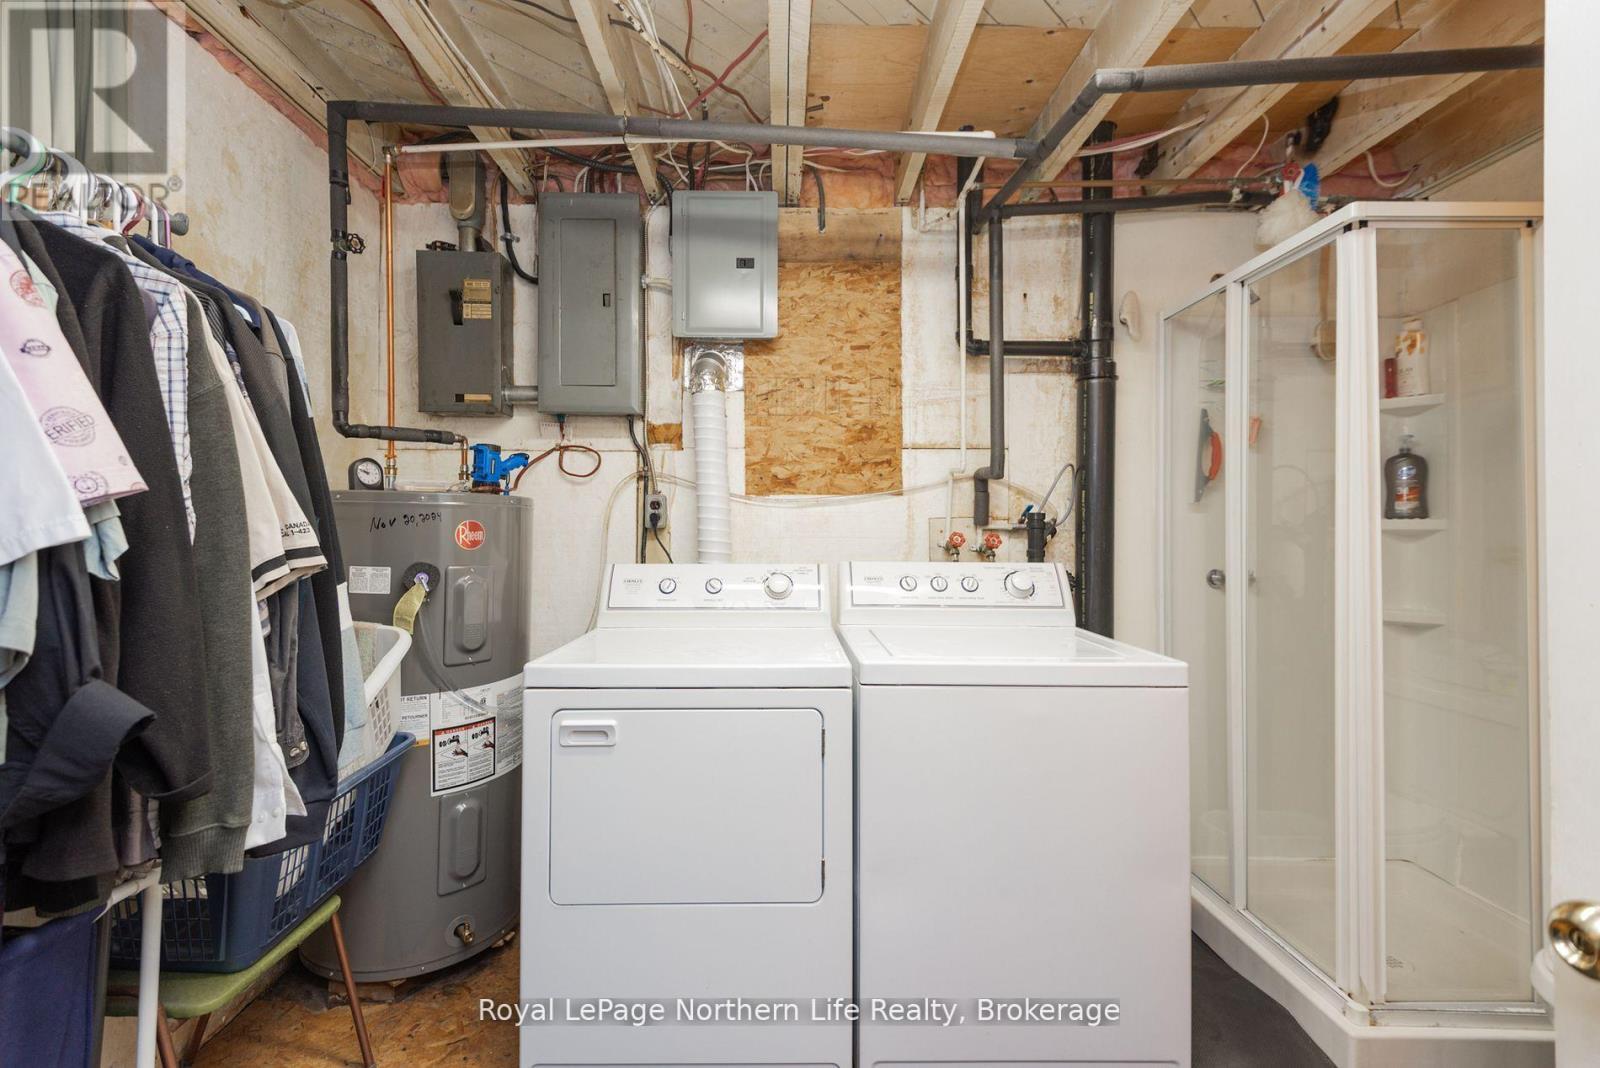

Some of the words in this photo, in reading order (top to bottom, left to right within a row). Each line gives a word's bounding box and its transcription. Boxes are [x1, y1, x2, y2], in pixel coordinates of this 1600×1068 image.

[45, 413, 95, 441] ERIFIED
[369, 517, 397, 533] Nov
[459, 520, 484, 545] Rheem
